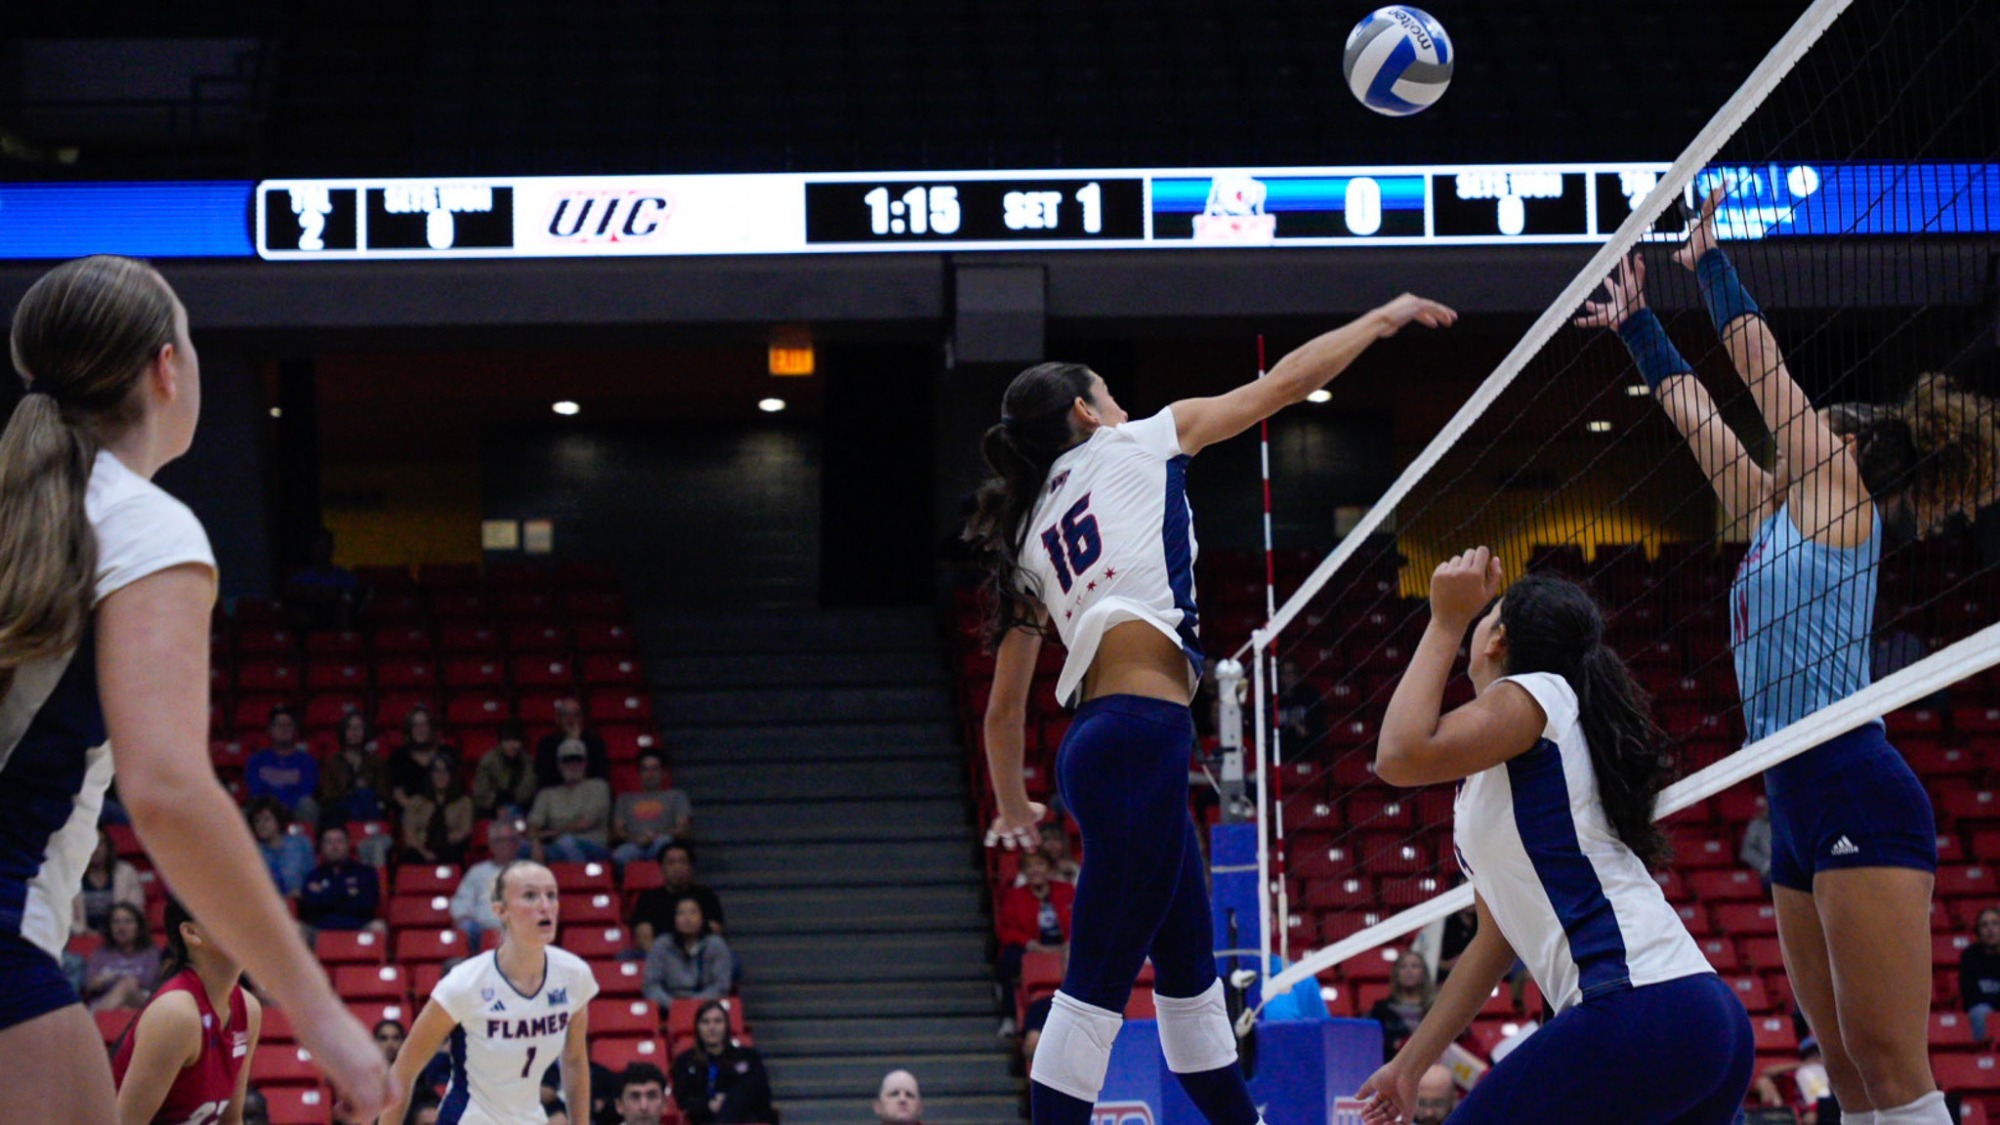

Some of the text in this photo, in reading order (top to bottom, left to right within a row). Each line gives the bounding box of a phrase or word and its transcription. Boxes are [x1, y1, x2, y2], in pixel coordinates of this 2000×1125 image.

[547, 195, 668, 239] UIC
[864, 185, 961, 236] 1:15
[1003, 183, 1103, 233] SET 1
[1344, 176, 1383, 236] 0
[1498, 194, 1525, 236] 0
[298, 209, 325, 251] 2
[427, 208, 454, 250] 0
[1041, 491, 1102, 595] 16
[487, 1011, 569, 1040] FLAMES
[520, 1046, 537, 1079] 1
